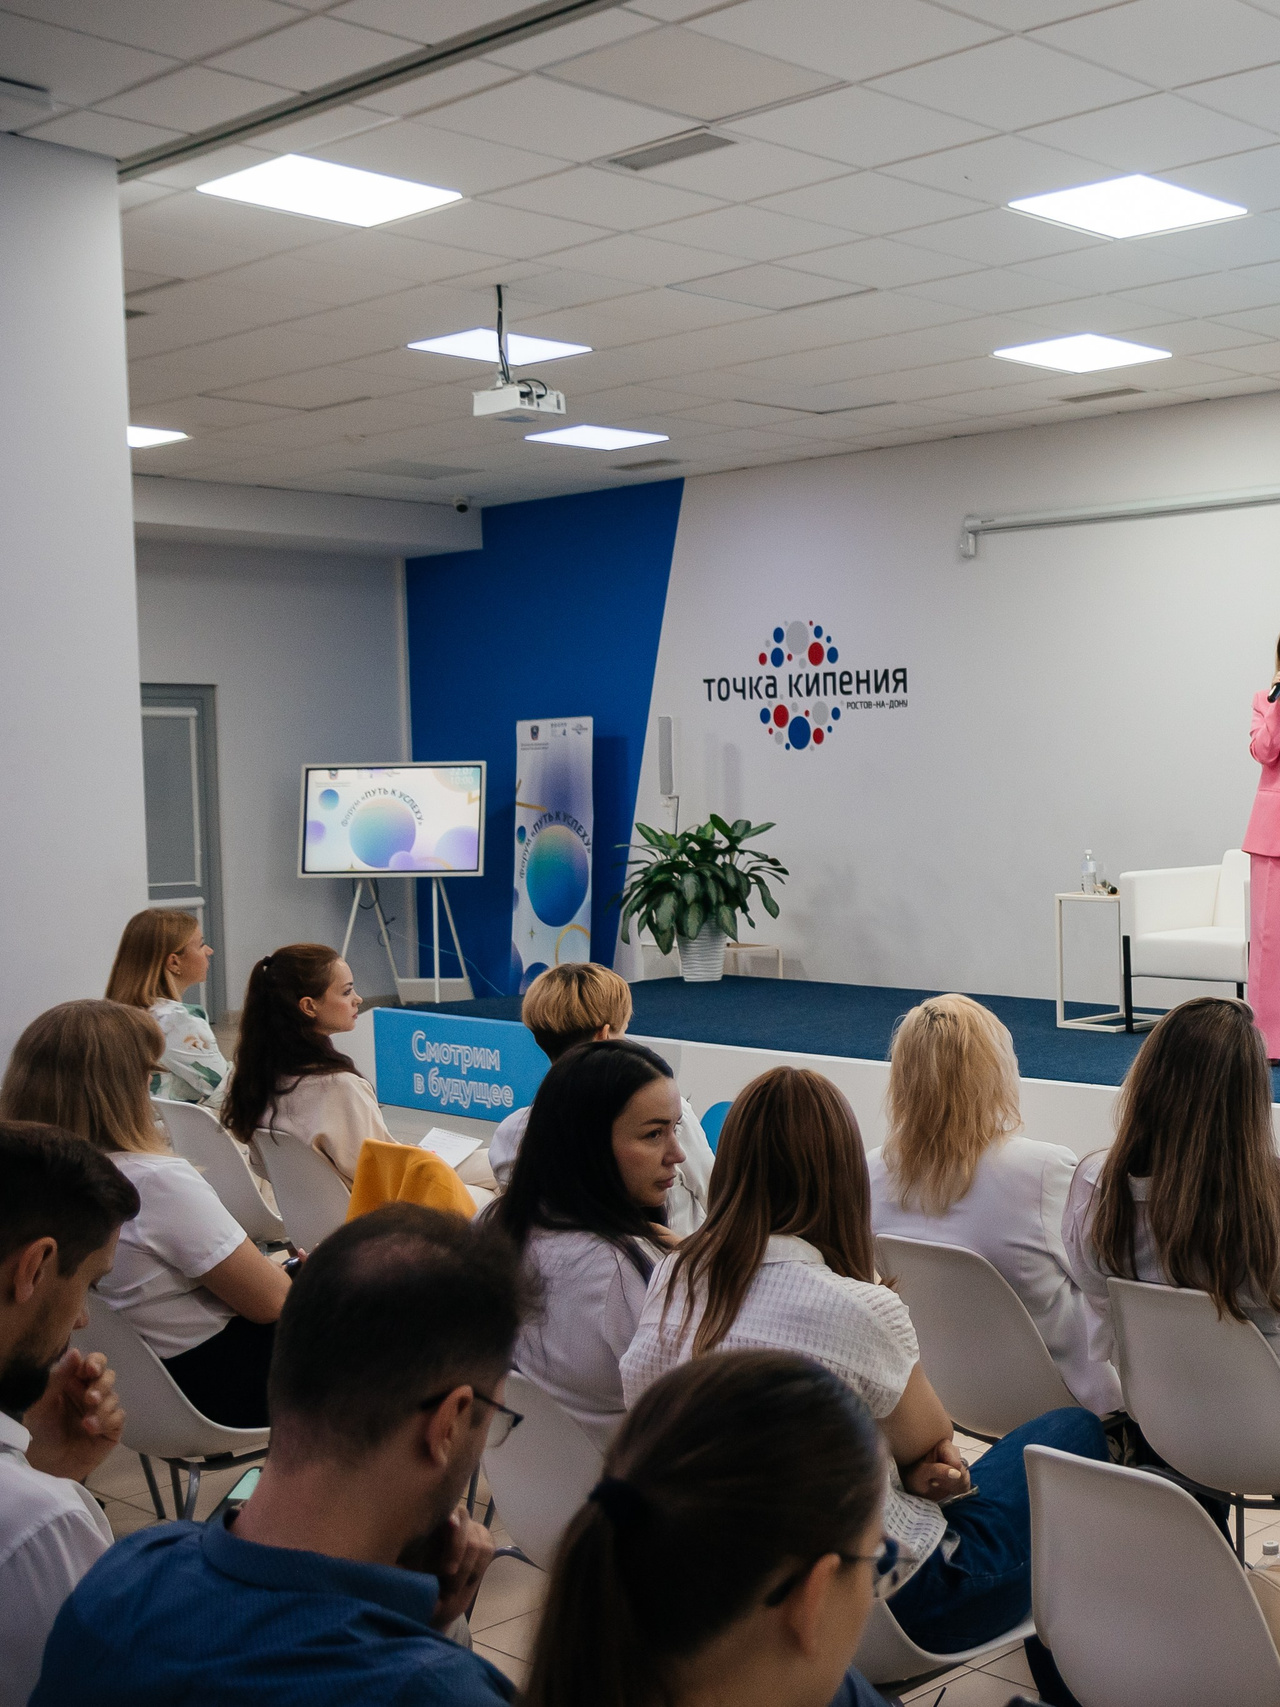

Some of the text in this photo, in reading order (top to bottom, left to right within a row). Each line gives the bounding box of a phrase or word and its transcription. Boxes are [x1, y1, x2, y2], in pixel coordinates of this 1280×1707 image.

[846, 700, 908, 710] РОСТОВ-НА-ДОНУ
[411, 1030, 500, 1075] Смотрим
[428, 1066, 514, 1109] будущее
